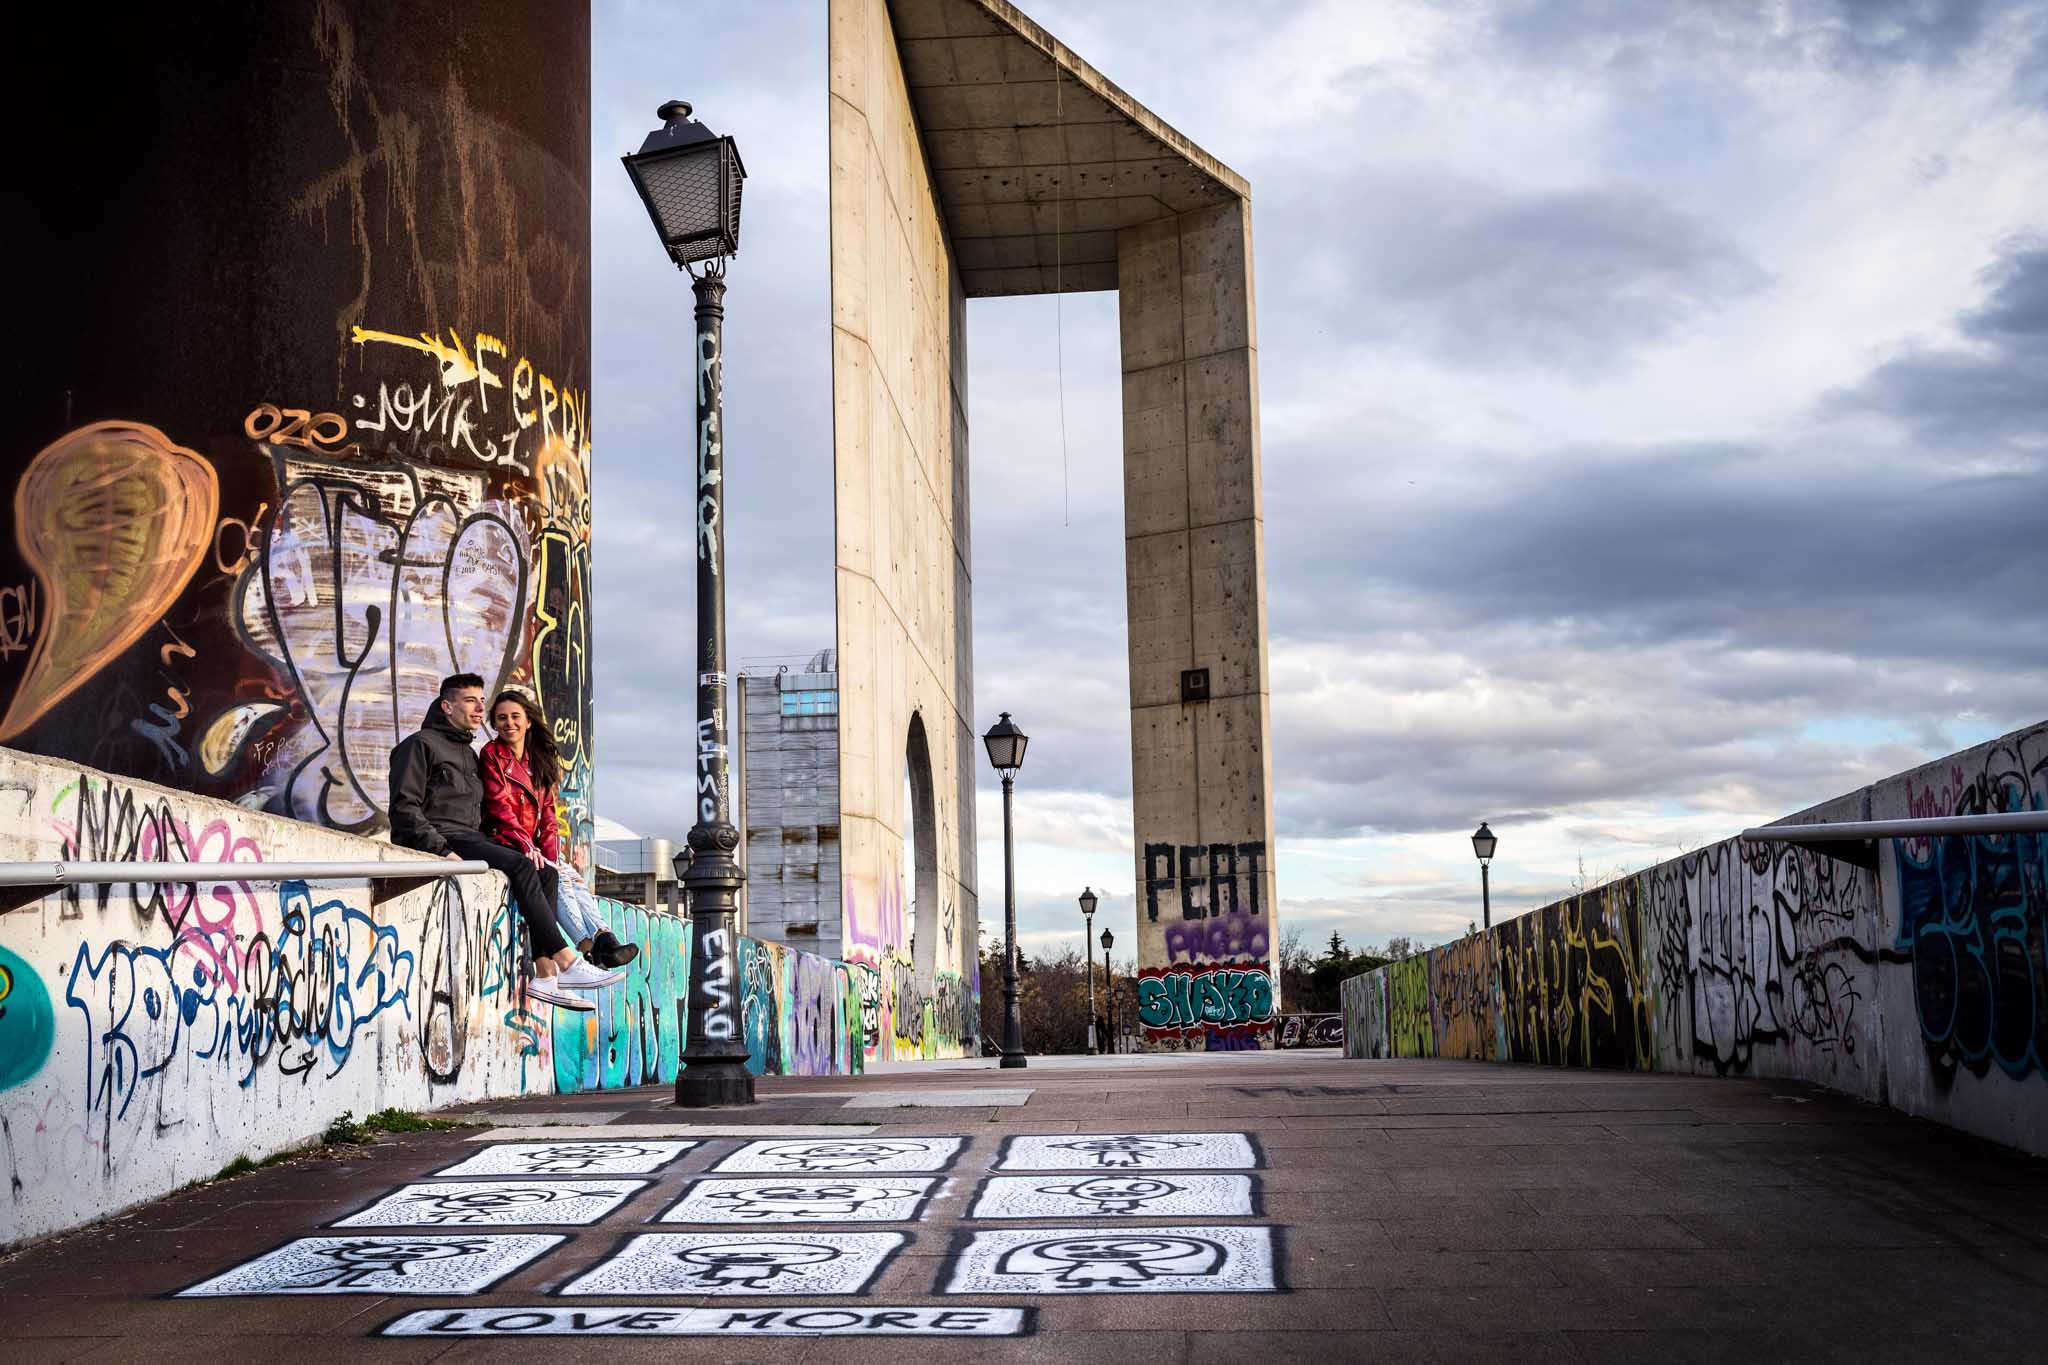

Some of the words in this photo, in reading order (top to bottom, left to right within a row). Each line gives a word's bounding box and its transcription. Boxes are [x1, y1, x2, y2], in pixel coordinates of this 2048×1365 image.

[1137, 969, 1273, 1030] SHAKO
[427, 1311, 682, 1333] LOVE
[718, 1310, 993, 1331] MORE
